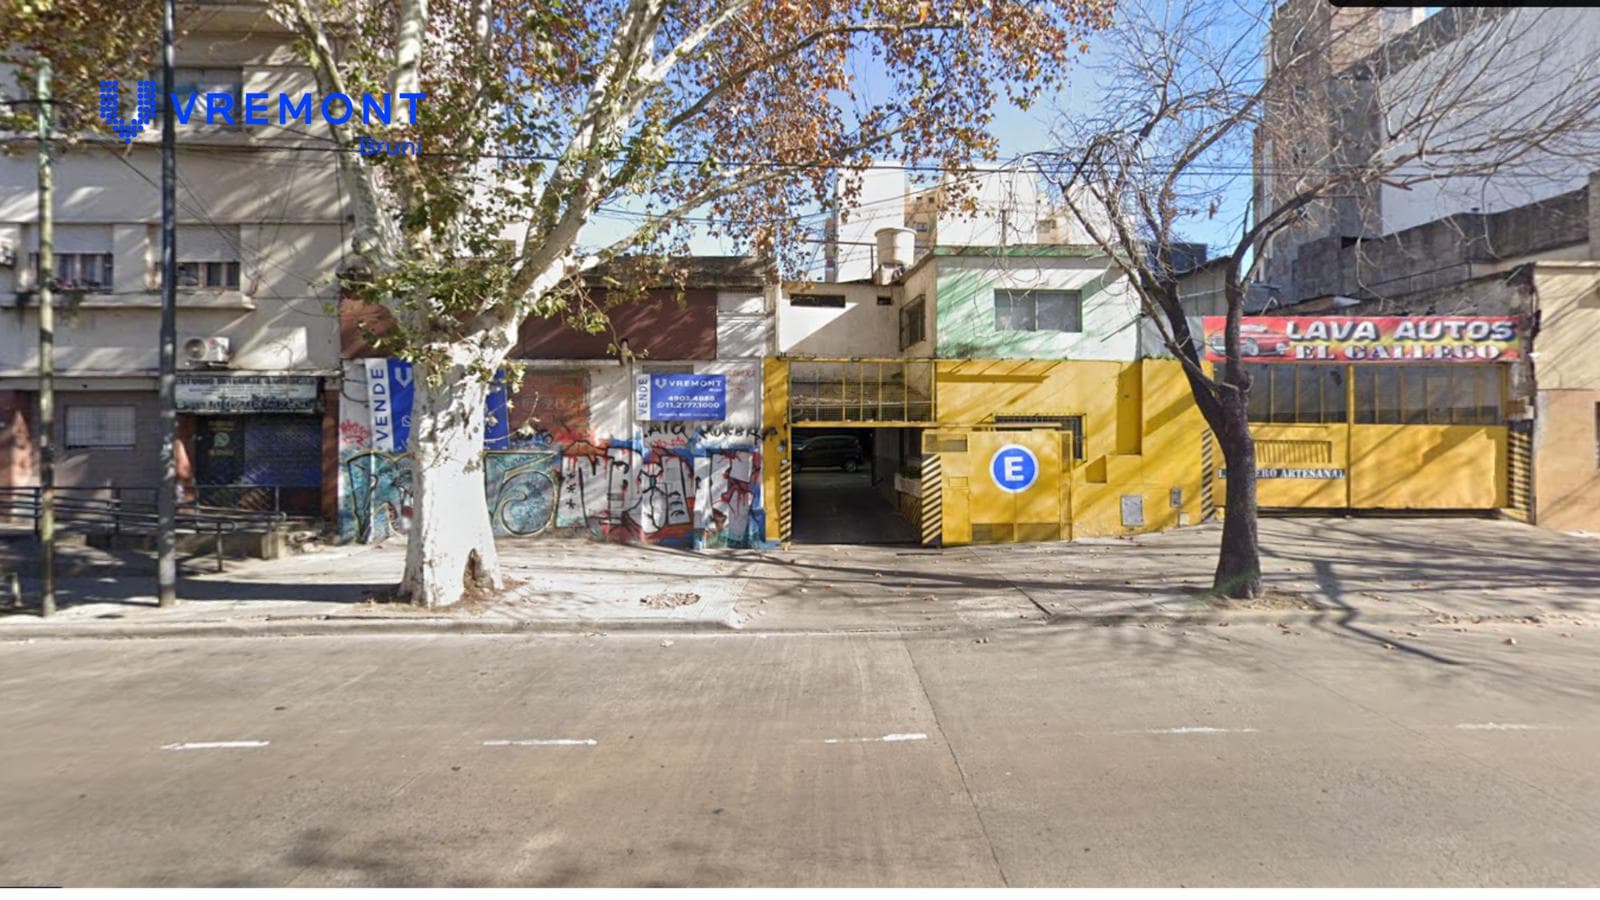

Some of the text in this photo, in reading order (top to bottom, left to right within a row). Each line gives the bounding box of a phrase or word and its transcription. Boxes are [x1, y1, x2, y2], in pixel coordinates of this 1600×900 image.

[1285, 320, 1517, 341] LAVA AUTOS
[1295, 344, 1500, 360] EL GALLEGO
[669, 380, 722, 388] VREMONT
[371, 368, 389, 441] VENDE
[639, 378, 648, 416] VENDE
[1004, 456, 1025, 481] E
[1280, 469, 1346, 479] ARTESANAL
